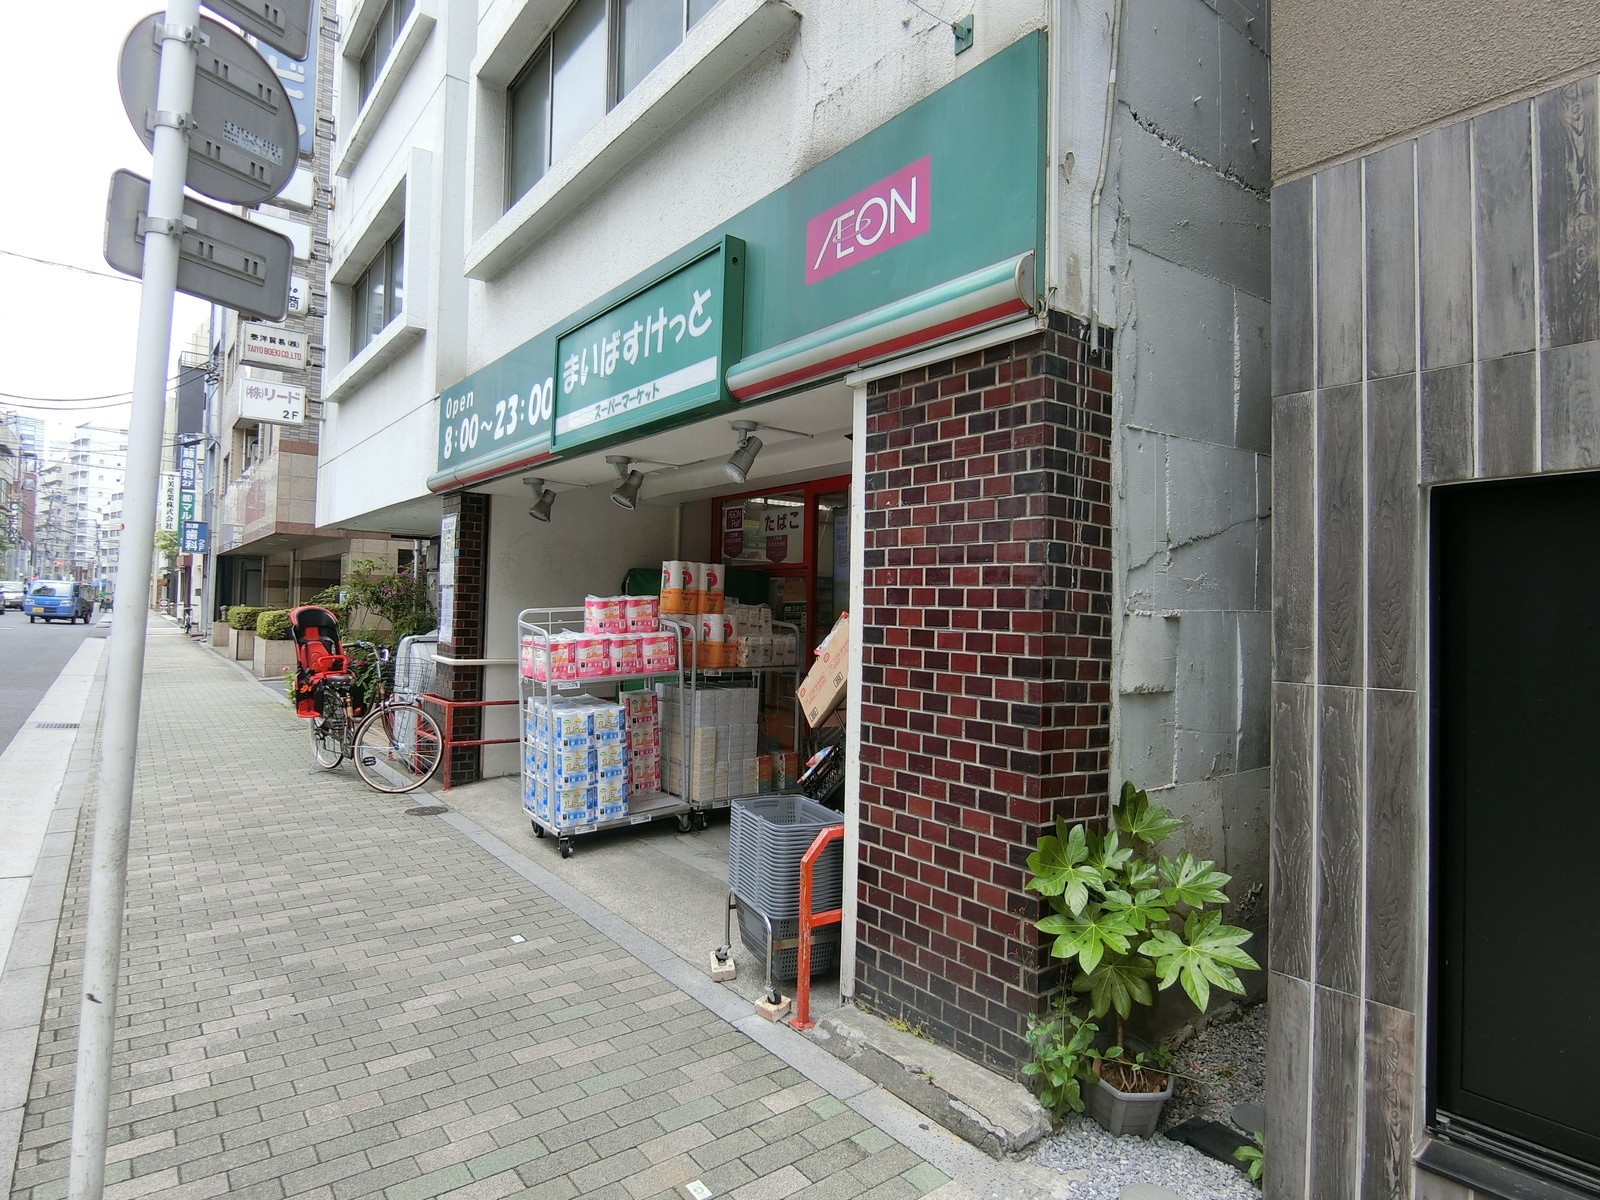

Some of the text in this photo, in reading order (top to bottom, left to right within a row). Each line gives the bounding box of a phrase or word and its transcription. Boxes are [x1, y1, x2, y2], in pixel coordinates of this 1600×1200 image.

[248, 344, 263, 353] TAIYO
[264, 348, 280, 356] BOEKI
[563, 288, 712, 394] まいばすけっと
[446, 390, 474, 419] Open
[594, 383, 659, 420] スーパーマーケット
[283, 410, 299, 419] 2F
[765, 512, 799, 531] たばこ
